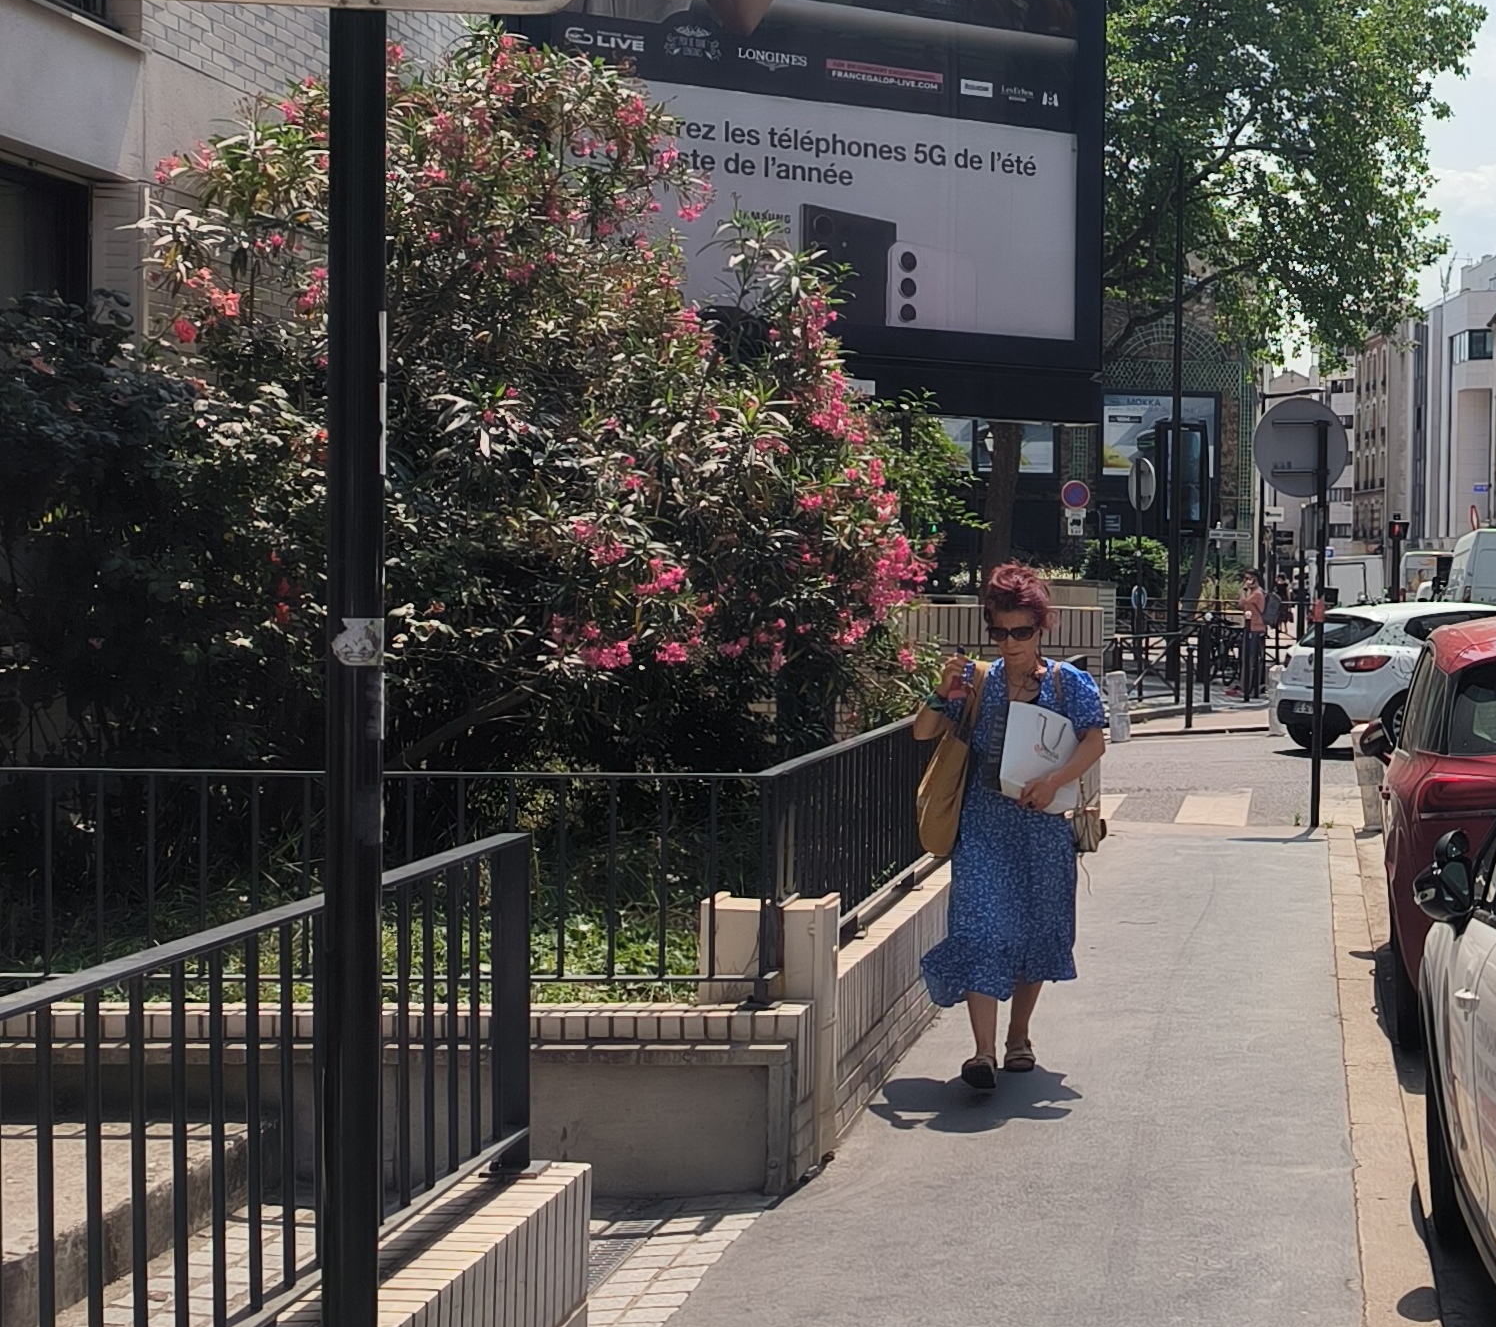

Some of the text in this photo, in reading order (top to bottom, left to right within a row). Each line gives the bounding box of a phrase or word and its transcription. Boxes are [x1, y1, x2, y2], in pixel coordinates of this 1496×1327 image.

[597, 35, 645, 52] LIVE
[738, 47, 808, 68] LONGINES
[724, 120, 761, 145] les
[768, 126, 907, 162] téléphones
[914, 142, 947, 167] 5G
[954, 147, 983, 171] de
[989, 150, 1037, 177] l'été
[724, 151, 756, 176] de
[763, 155, 854, 186] l'année
[1126, 397, 1162, 408] MOKKA
